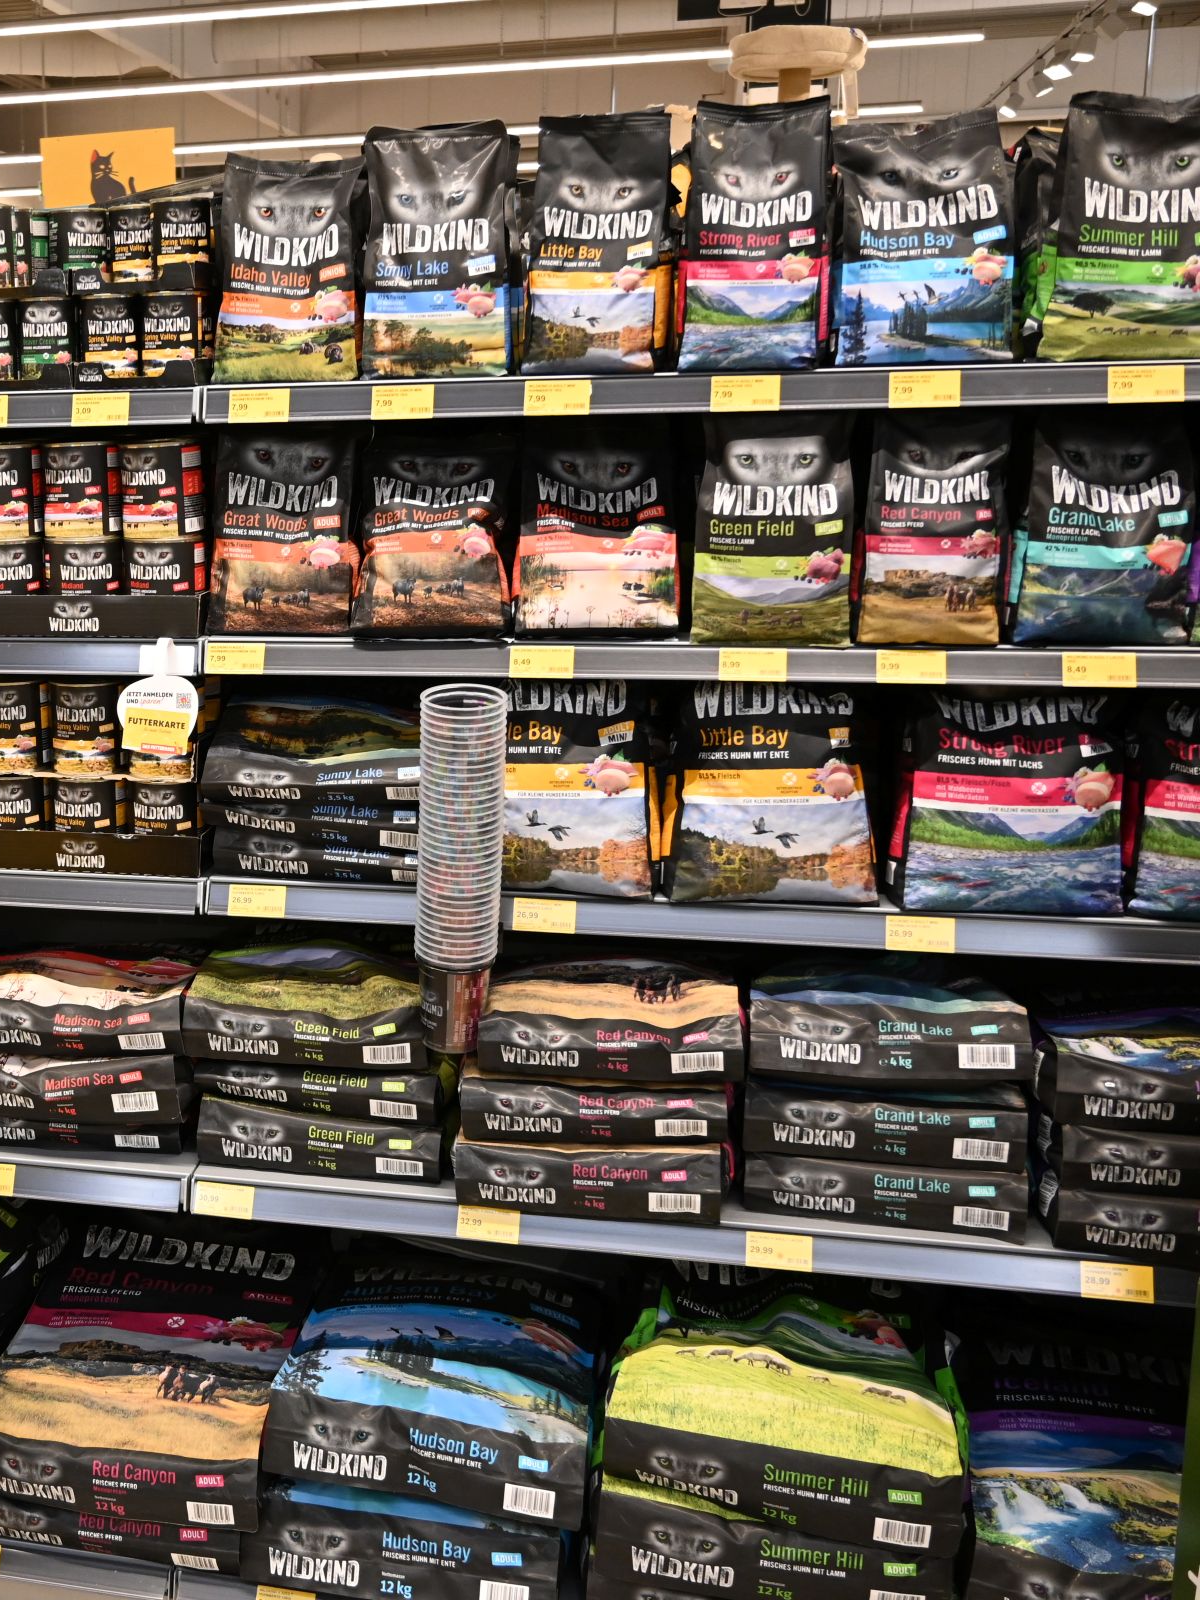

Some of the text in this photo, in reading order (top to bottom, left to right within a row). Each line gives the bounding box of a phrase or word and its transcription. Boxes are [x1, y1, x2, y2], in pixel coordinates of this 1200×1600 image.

[702, 191, 812, 228] WILDKIND
[858, 184, 998, 230] WILDKIND
[1085, 177, 1200, 223] WILDKIN
[544, 206, 652, 240] WILDKIND
[234, 223, 339, 266] WILDKIND
[382, 218, 489, 256] WILDKIND
[700, 231, 781, 248] Strong River
[860, 230, 955, 250] Hudson Bay
[1079, 224, 1178, 246] Summer Hill
[540, 244, 602, 260] Little Bay
[231, 263, 311, 288] Idaho Valley
[376, 261, 448, 279] Sunny Lake
[714, 390, 733, 399] 7,99
[894, 386, 913, 394] 7,99
[1113, 381, 1132, 389] 7,99
[231, 403, 248, 411] 7,99
[375, 399, 392, 407] 7,99
[528, 394, 545, 403] 7,99
[229, 472, 338, 512] WILDKIND
[373, 477, 494, 508] WILDKIND
[537, 472, 657, 513] WILDKIND
[713, 482, 837, 516] WILDKIND
[1052, 465, 1181, 514] WILDKIND
[224, 510, 307, 531] Great Woods
[375, 508, 459, 527] Great Woods
[537, 504, 629, 527] Madison Sea
[881, 506, 961, 523] Red Canyon
[1048, 507, 1135, 532] Grand Lake
[710, 519, 794, 536] Green Field
[210, 655, 226, 663] 7,99
[514, 658, 530, 666] 8,49
[722, 660, 740, 668] 8,99
[1066, 665, 1086, 674] 8,49
[128, 717, 185, 729] FUTTERKARTE
[529, 721, 562, 744] Bay
[700, 725, 788, 748] Little Bay
[939, 728, 1066, 758] Strong River
[509, 746, 527, 754] HUHN
[544, 746, 562, 754] ENTE
[698, 751, 789, 760] FRISCHES HUHN MIT ENTE
[938, 754, 1043, 769] FRISCHES HUHN MIT LACHS
[228, 785, 300, 800] WILDKIND
[225, 810, 295, 834] WILDKIND
[232, 896, 252, 904] 26,99
[516, 911, 538, 919] 26,99
[889, 930, 913, 938] 26,99
[597, 1029, 671, 1044] Red Canyon
[879, 1019, 952, 1037] Grand Lake
[780, 1036, 861, 1065] WILDKIND
[45, 1073, 113, 1090] Madison Sea
[875, 1108, 950, 1126] Grand Lake
[1083, 1095, 1174, 1120] WILDKIND
[308, 1126, 374, 1146] Green Field
[773, 1122, 855, 1149] WILDKIND
[221, 1138, 293, 1163] WILDKIND
[573, 1163, 647, 1182] Red Canyon
[1090, 1163, 1180, 1187] WILDKIND
[461, 1217, 481, 1226] 32,99
[83, 1224, 297, 1282] WILDKIND
[750, 1246, 773, 1255] 29,99
[1084, 1276, 1109, 1285] 28,99
[409, 1427, 499, 1466] Hudson Bay
[293, 1441, 387, 1481] WILDKIND
[92, 1459, 176, 1485] Red Canyon
[763, 1463, 869, 1499] Summer Hill
[636, 1469, 738, 1507] WILDKIND
[891, 1492, 919, 1505] ADULT
[383, 1532, 471, 1563] Hudson Bay
[887, 1564, 915, 1576] ADULT
